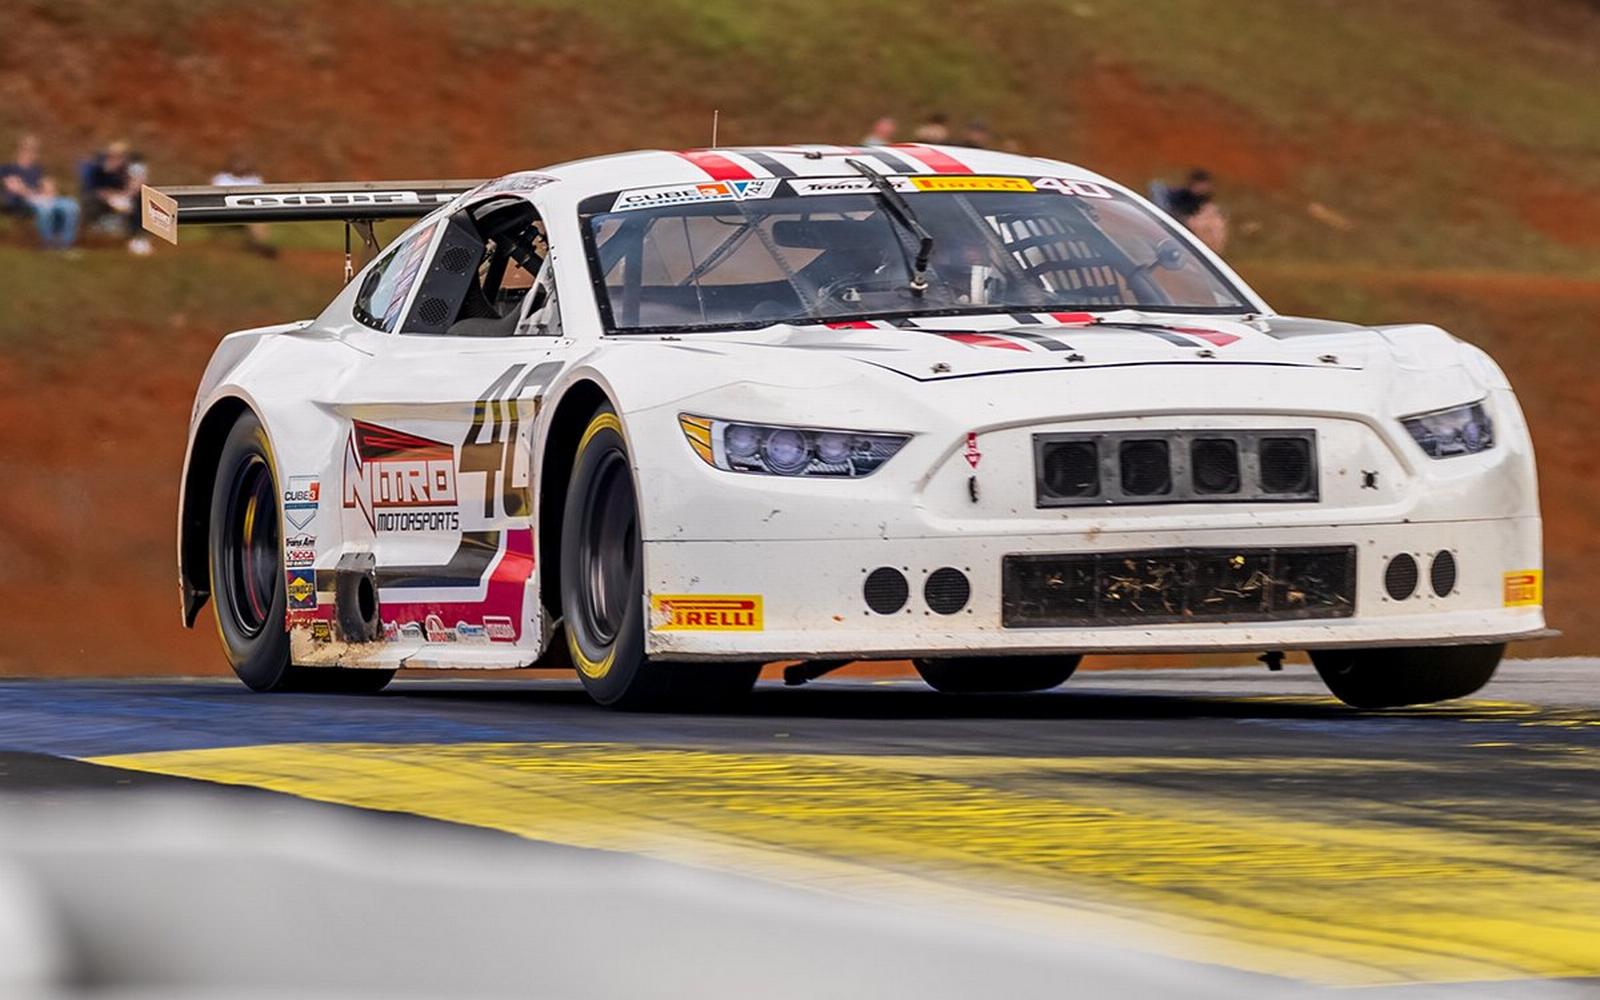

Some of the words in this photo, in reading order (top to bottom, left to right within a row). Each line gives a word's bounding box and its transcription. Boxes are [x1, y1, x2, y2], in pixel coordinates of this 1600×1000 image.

[1032, 177, 1112, 199] 40
[459, 361, 565, 518] 40
[377, 512, 459, 531] MOTORSPORTS
